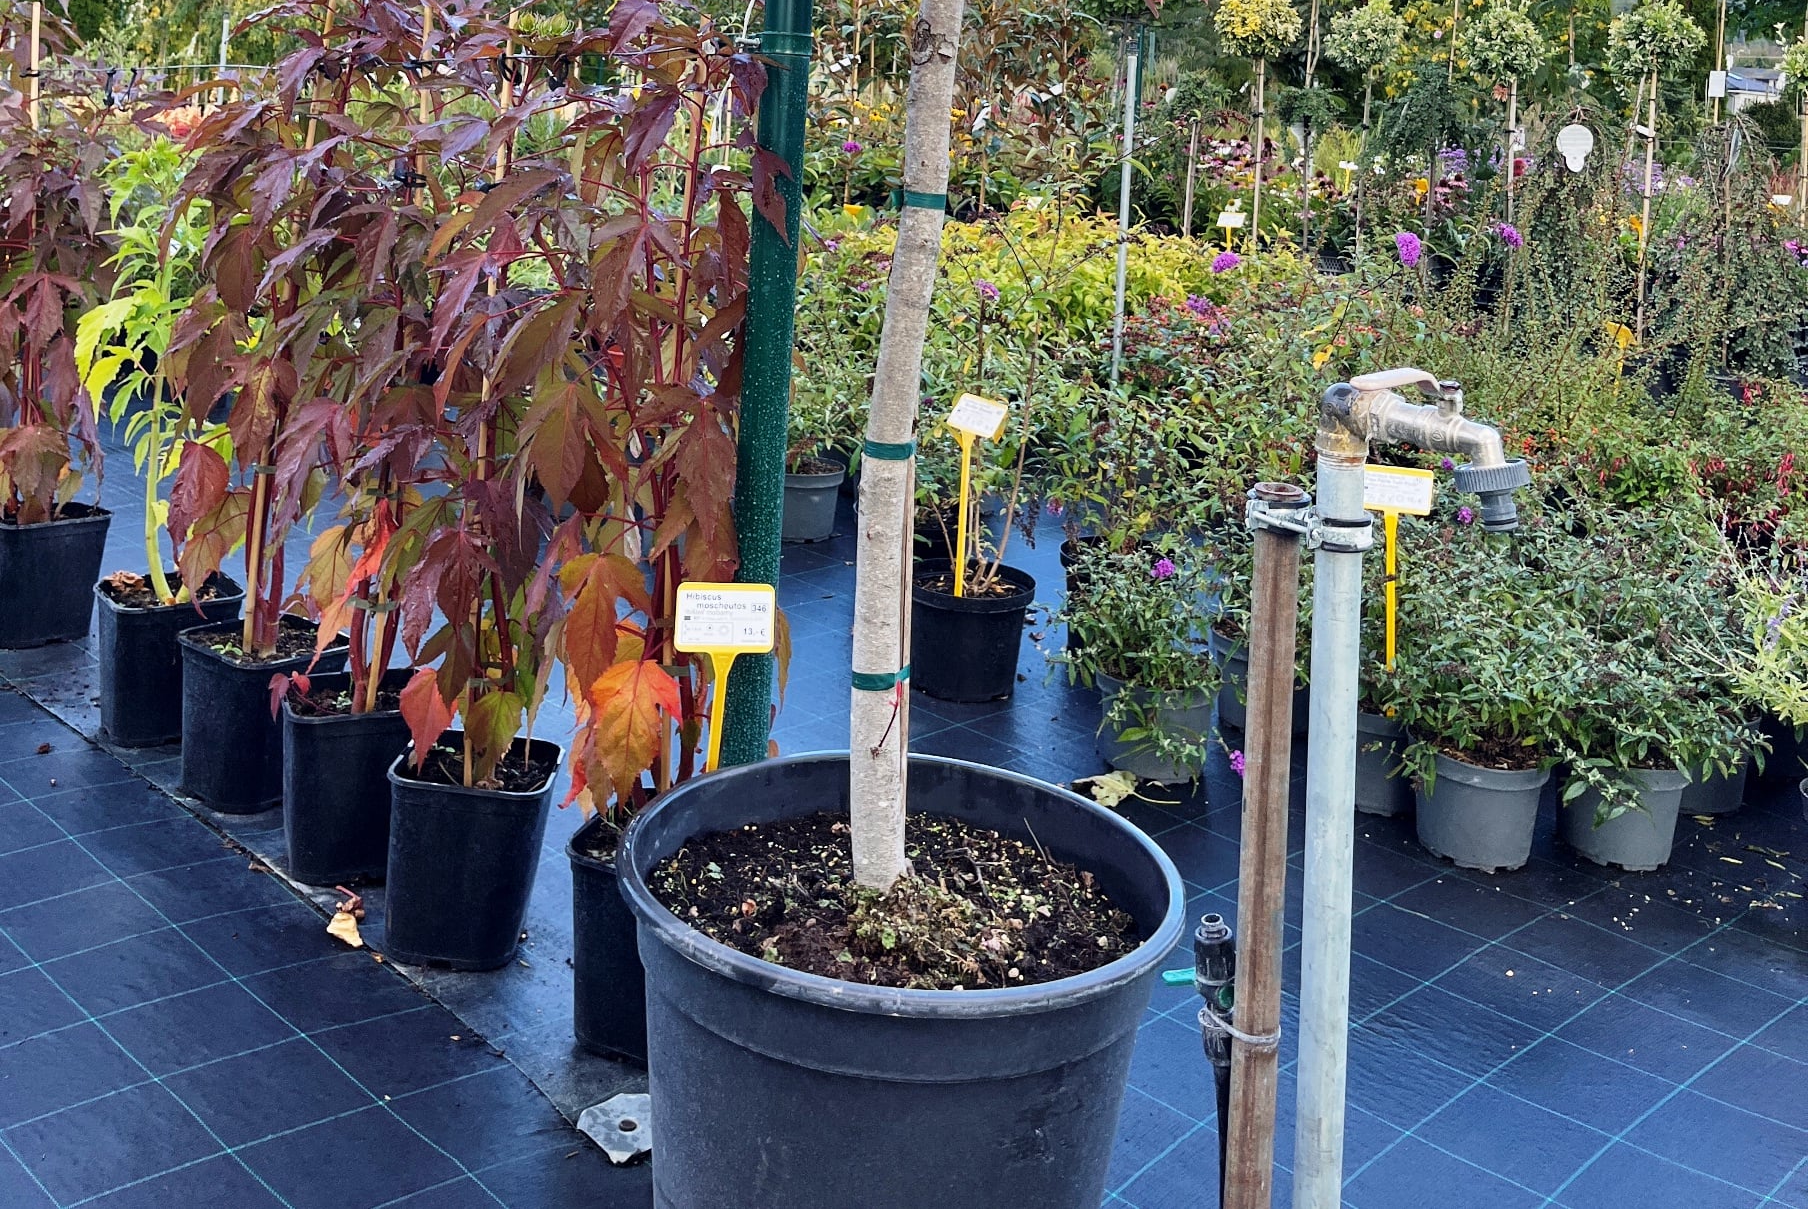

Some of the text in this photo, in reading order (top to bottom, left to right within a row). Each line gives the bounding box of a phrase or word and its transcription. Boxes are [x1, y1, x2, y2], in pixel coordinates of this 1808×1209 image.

[686, 593, 722, 601] Hibiscus
[696, 602, 747, 610] moscheutos
[751, 604, 767, 613] 346
[760, 628, 766, 636] €
